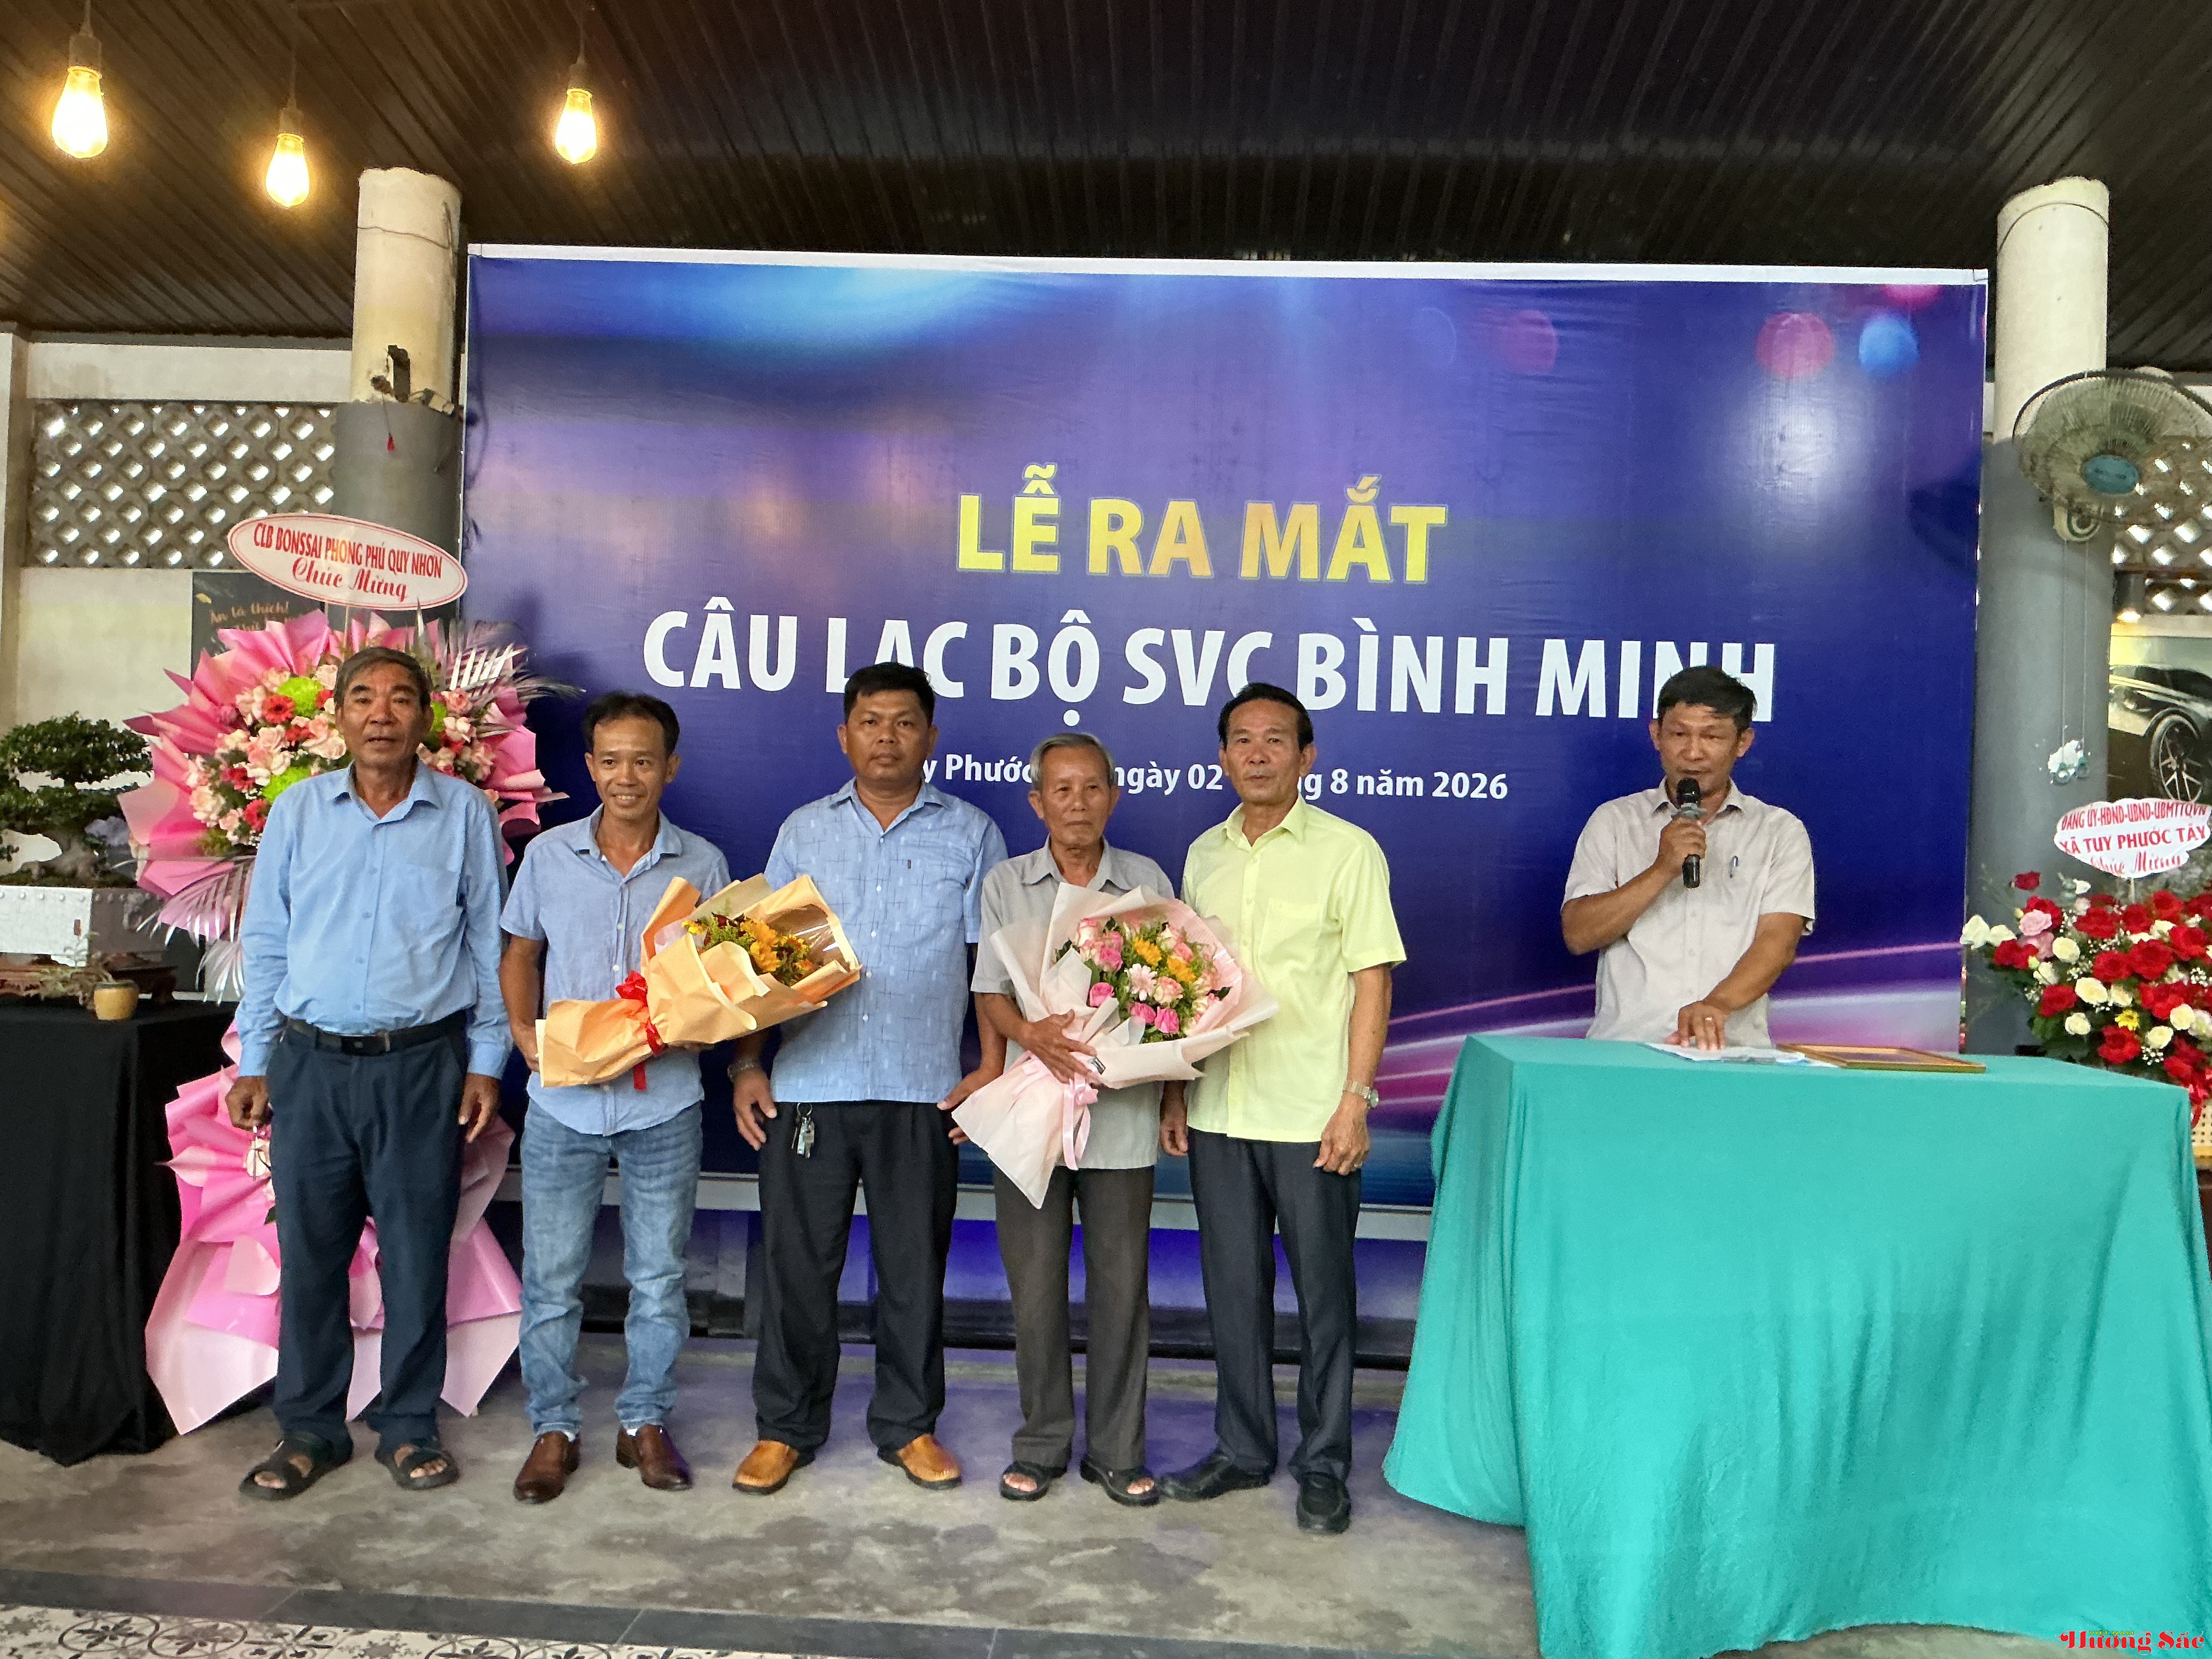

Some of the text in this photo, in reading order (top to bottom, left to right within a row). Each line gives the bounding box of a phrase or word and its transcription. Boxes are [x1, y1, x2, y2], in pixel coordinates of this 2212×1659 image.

[957, 464, 1447, 583] LỄ RA MẮT
[253, 522, 442, 579] CLB BONSSAI PHONG PHÚ QUY NHƠN
[292, 557, 408, 602] Chúc Mừng
[643, 596, 798, 691] CÂU
[991, 610, 1099, 726] BỘ
[1122, 628, 1273, 706] SVC
[1296, 618, 1509, 715] BÌNH
[1188, 764, 1223, 790] 02
[1330, 768, 1348, 794] 8
[1356, 769, 1424, 797] năm
[1432, 771, 1508, 799] 2026
[2059, 823, 2205, 854] XÃ TUY PHƯỚC TÂY
